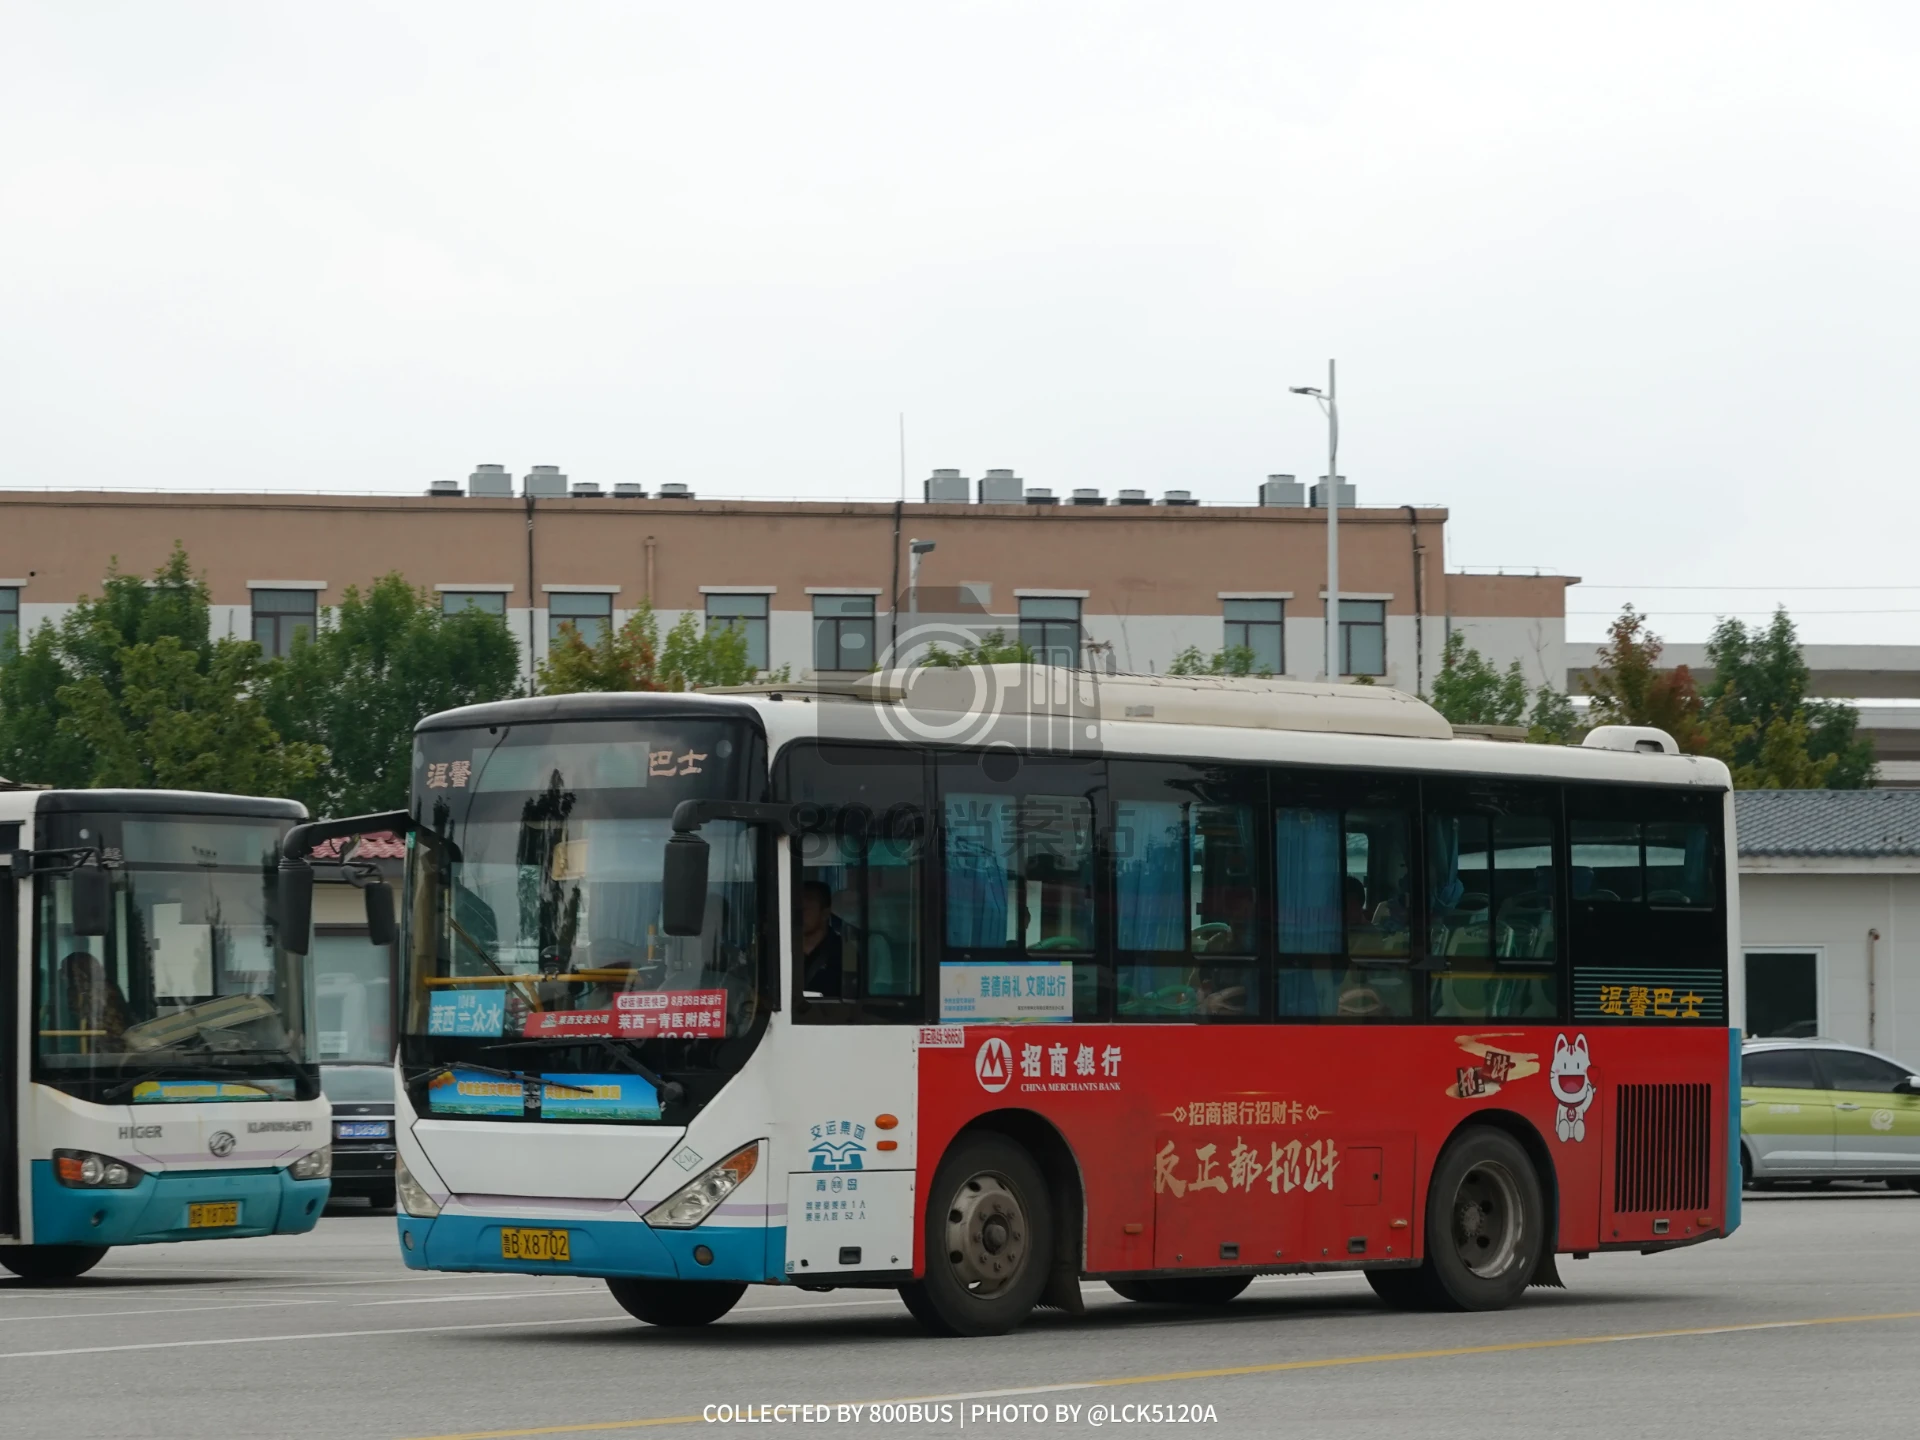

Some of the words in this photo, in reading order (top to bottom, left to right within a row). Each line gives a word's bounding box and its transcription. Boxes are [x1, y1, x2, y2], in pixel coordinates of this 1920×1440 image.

[426, 760, 472, 789] 温馨
[649, 749, 708, 777] 巴士
[980, 974, 1022, 998] 崇德尚礼
[1025, 974, 1067, 998] 文明出行
[1600, 984, 1704, 1019] 温馨巴士
[1020, 1042, 1122, 1077] 招商银行
[1020, 1084, 1047, 1093] CHINA
[1048, 1083, 1098, 1092] MERCHANTS
[1098, 1082, 1121, 1091] BANK
[1188, 1100, 1304, 1126] 招商银行招财卡
[118, 1124, 163, 1140] HIGER
[810, 1120, 867, 1141] 交运集团
